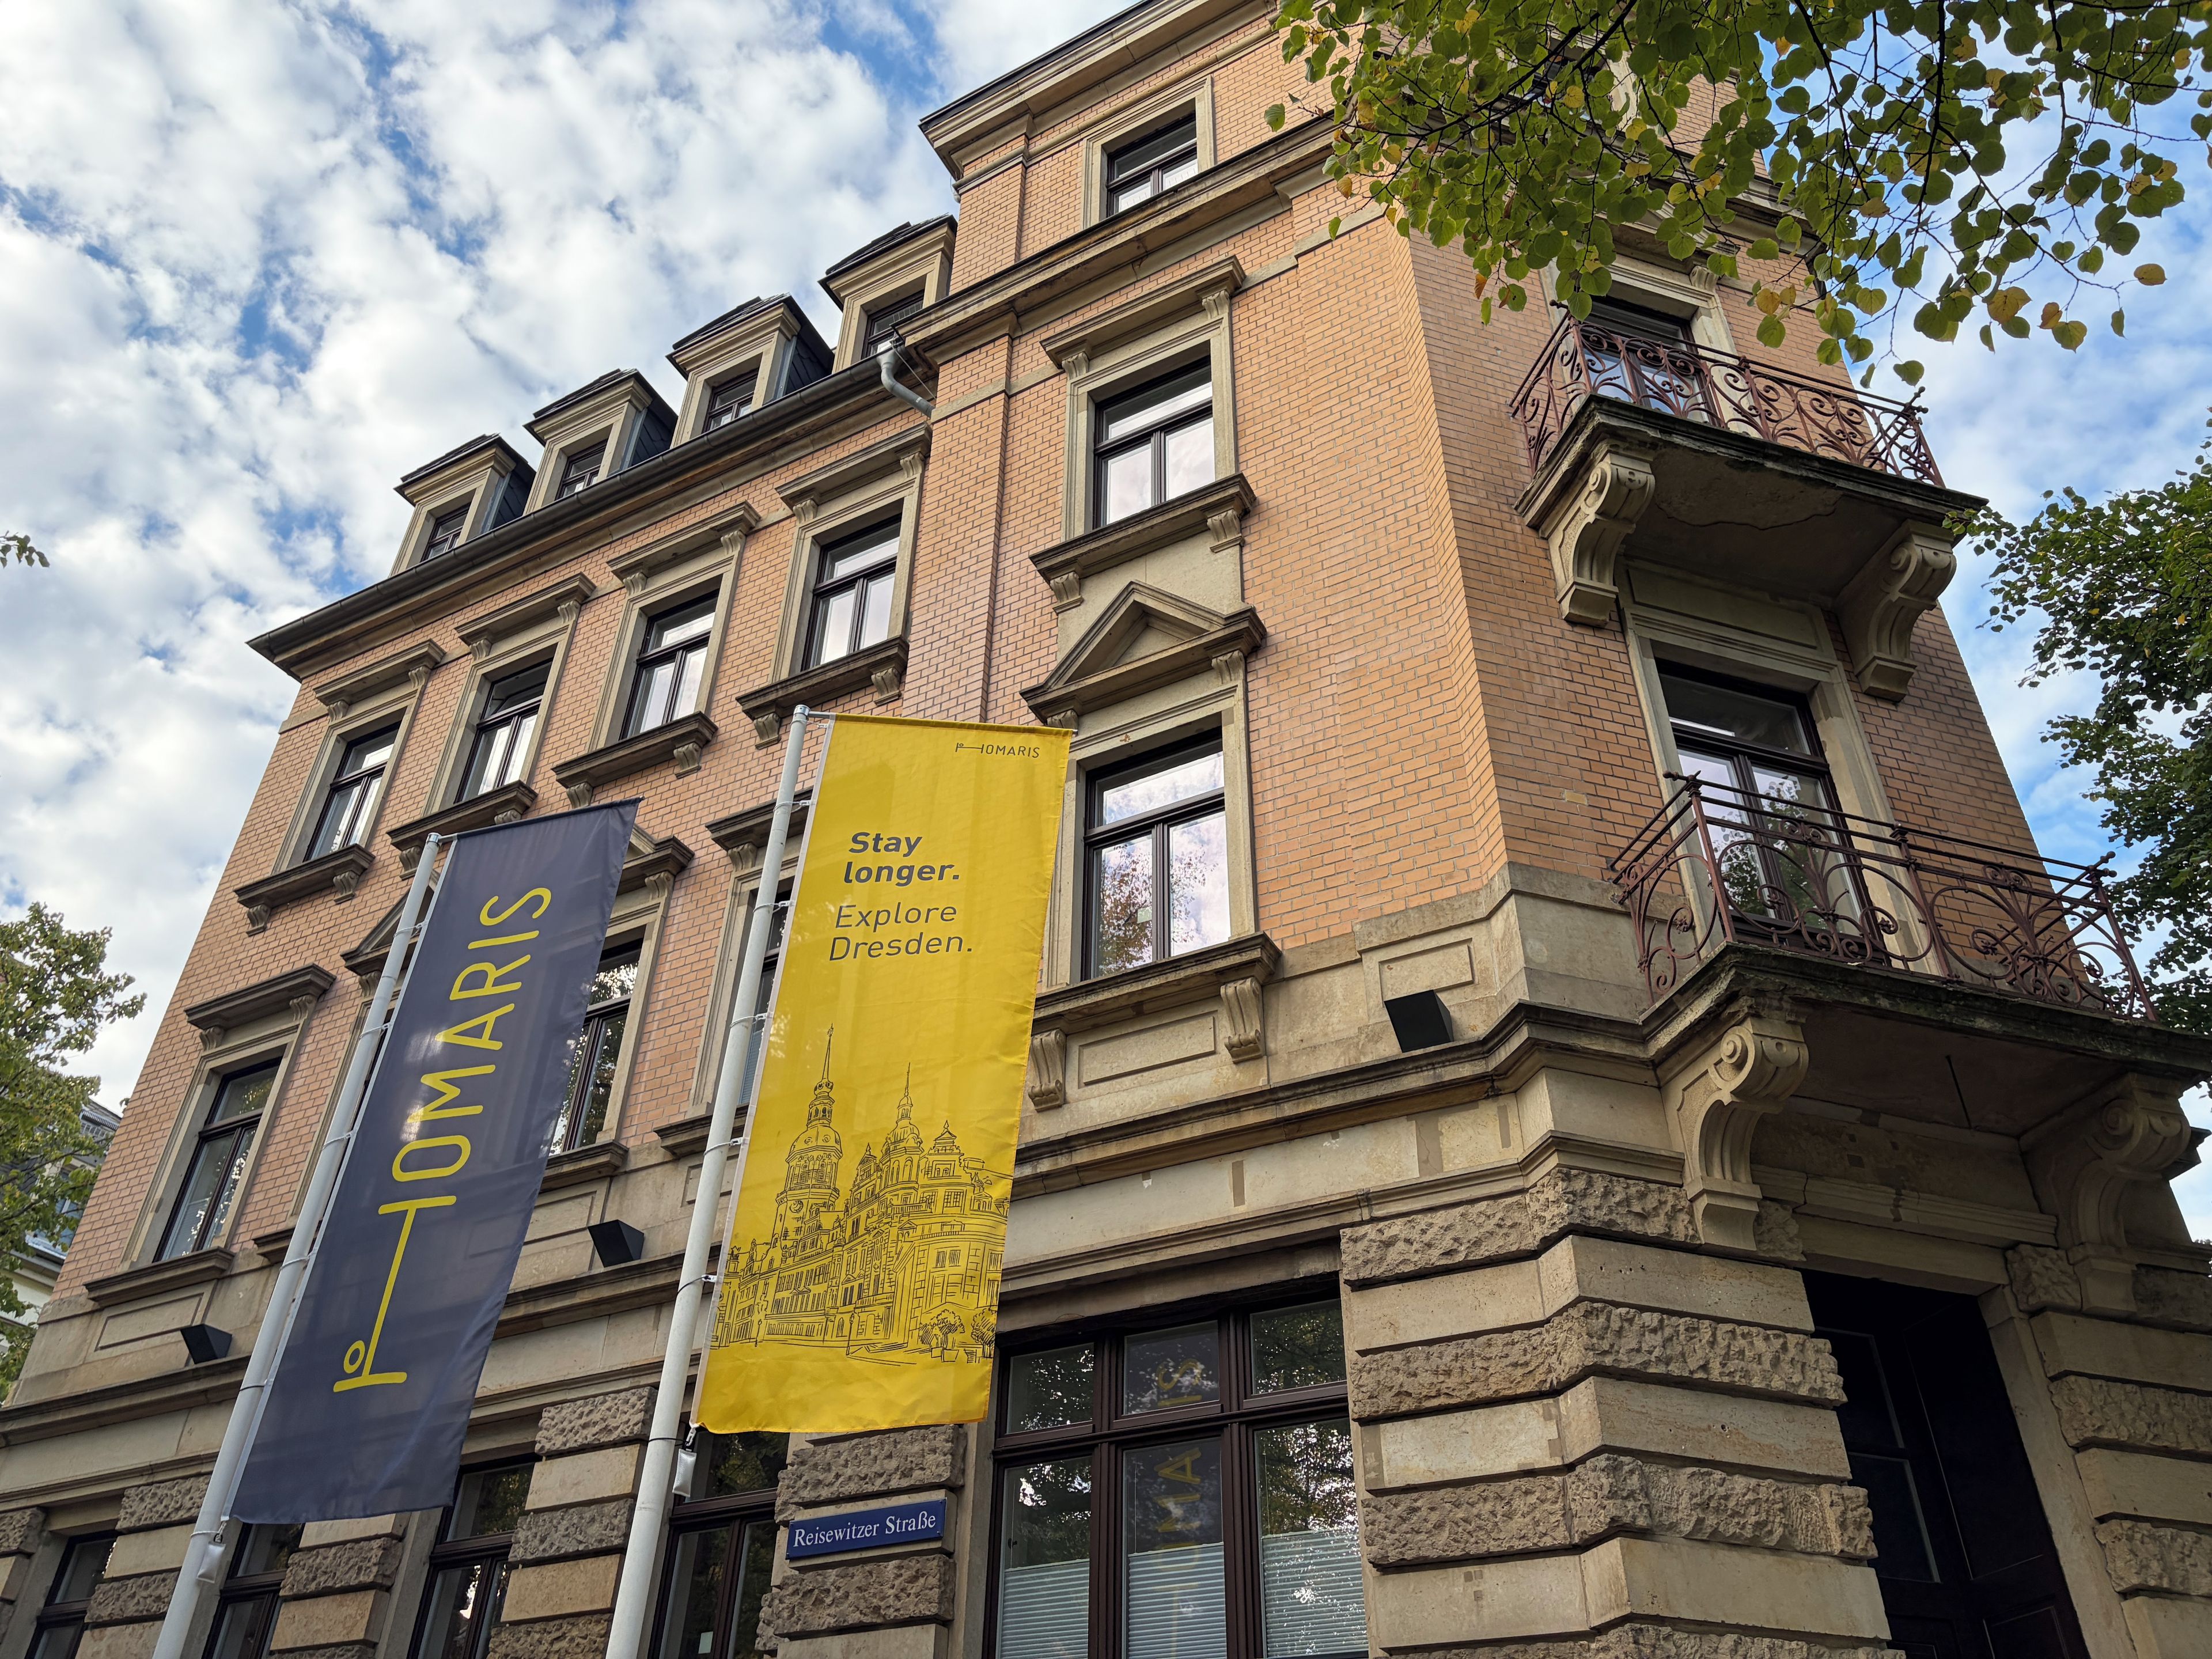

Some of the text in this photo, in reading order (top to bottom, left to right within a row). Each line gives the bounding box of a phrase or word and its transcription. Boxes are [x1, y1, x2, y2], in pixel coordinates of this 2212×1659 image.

[849, 832, 922, 857] Stay
[844, 862, 960, 887] longer.
[836, 902, 957, 932] Explore
[830, 933, 973, 961] Dresden.
[793, 1510, 936, 1547] Reisewitzer Straße
